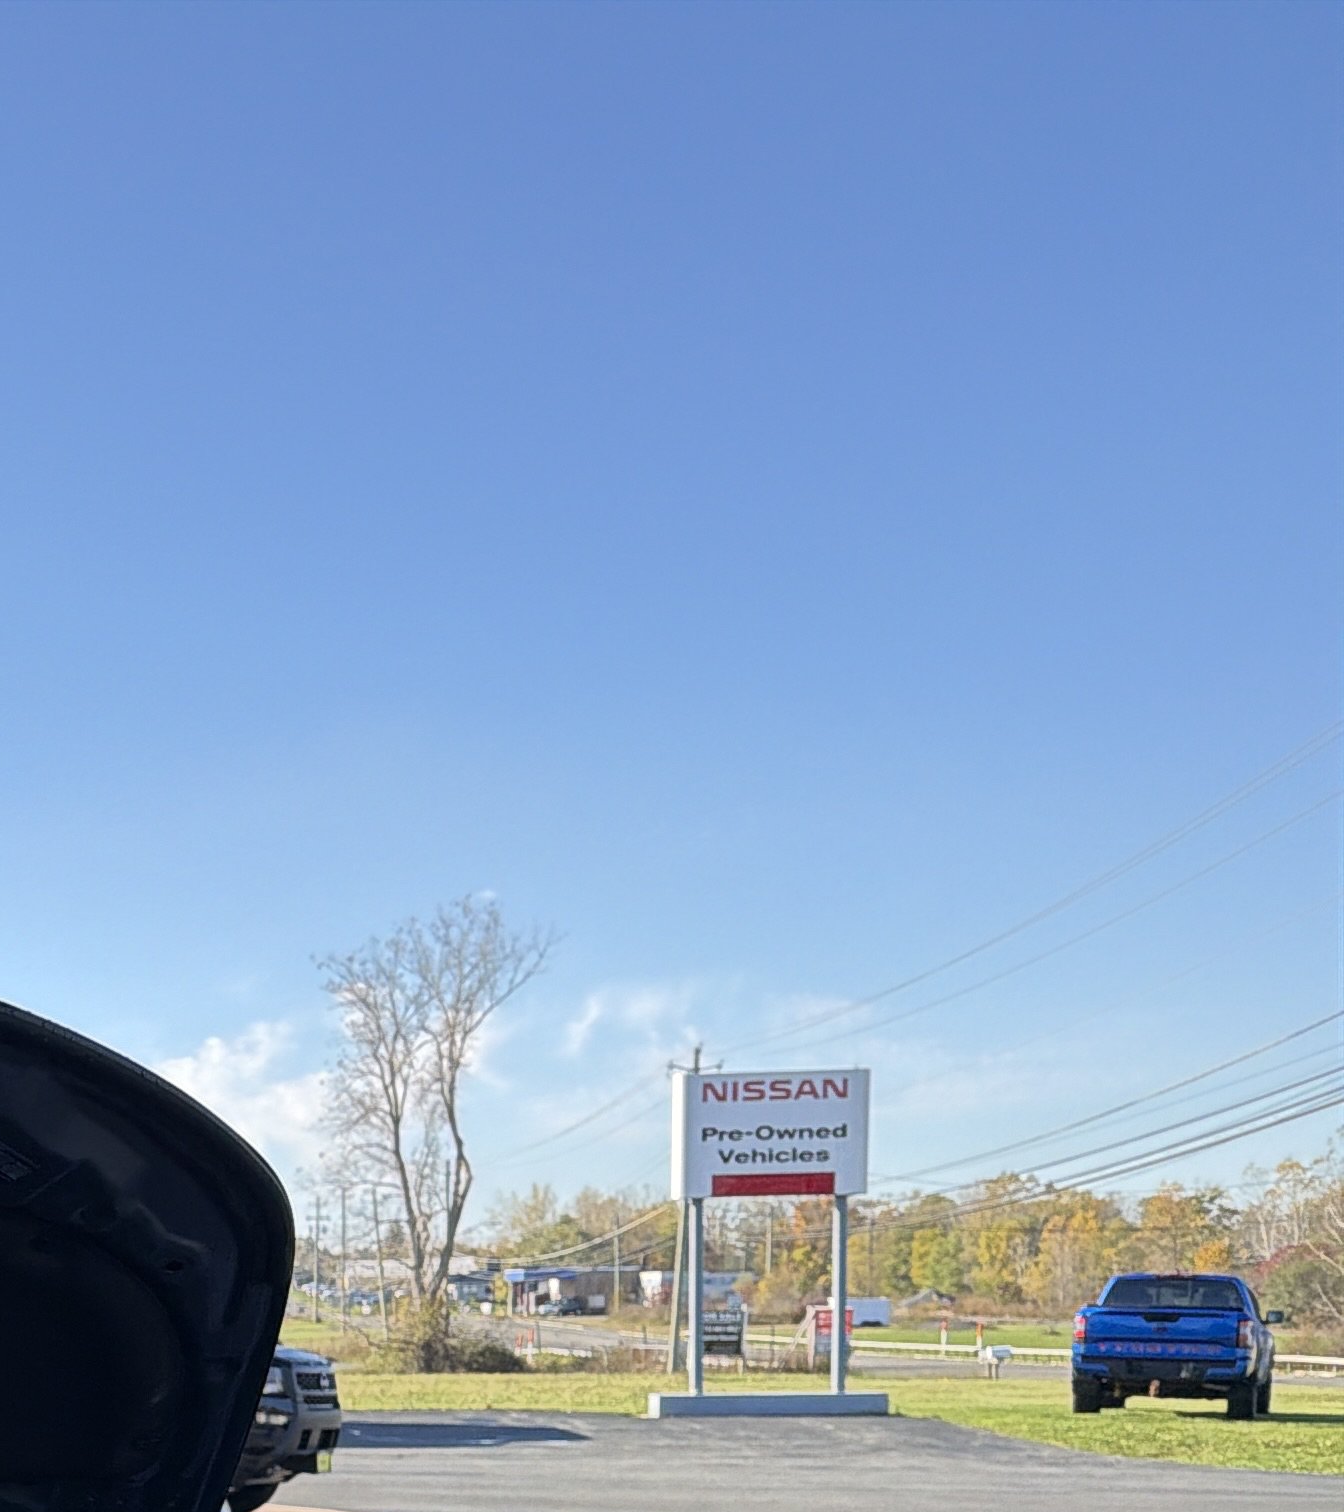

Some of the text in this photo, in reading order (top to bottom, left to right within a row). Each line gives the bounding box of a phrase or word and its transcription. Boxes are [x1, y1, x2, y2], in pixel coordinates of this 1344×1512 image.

[702, 1077, 849, 1102] NISSAN
[701, 1123, 848, 1142] Pre-Owned
[718, 1148, 831, 1164] Vehicles
